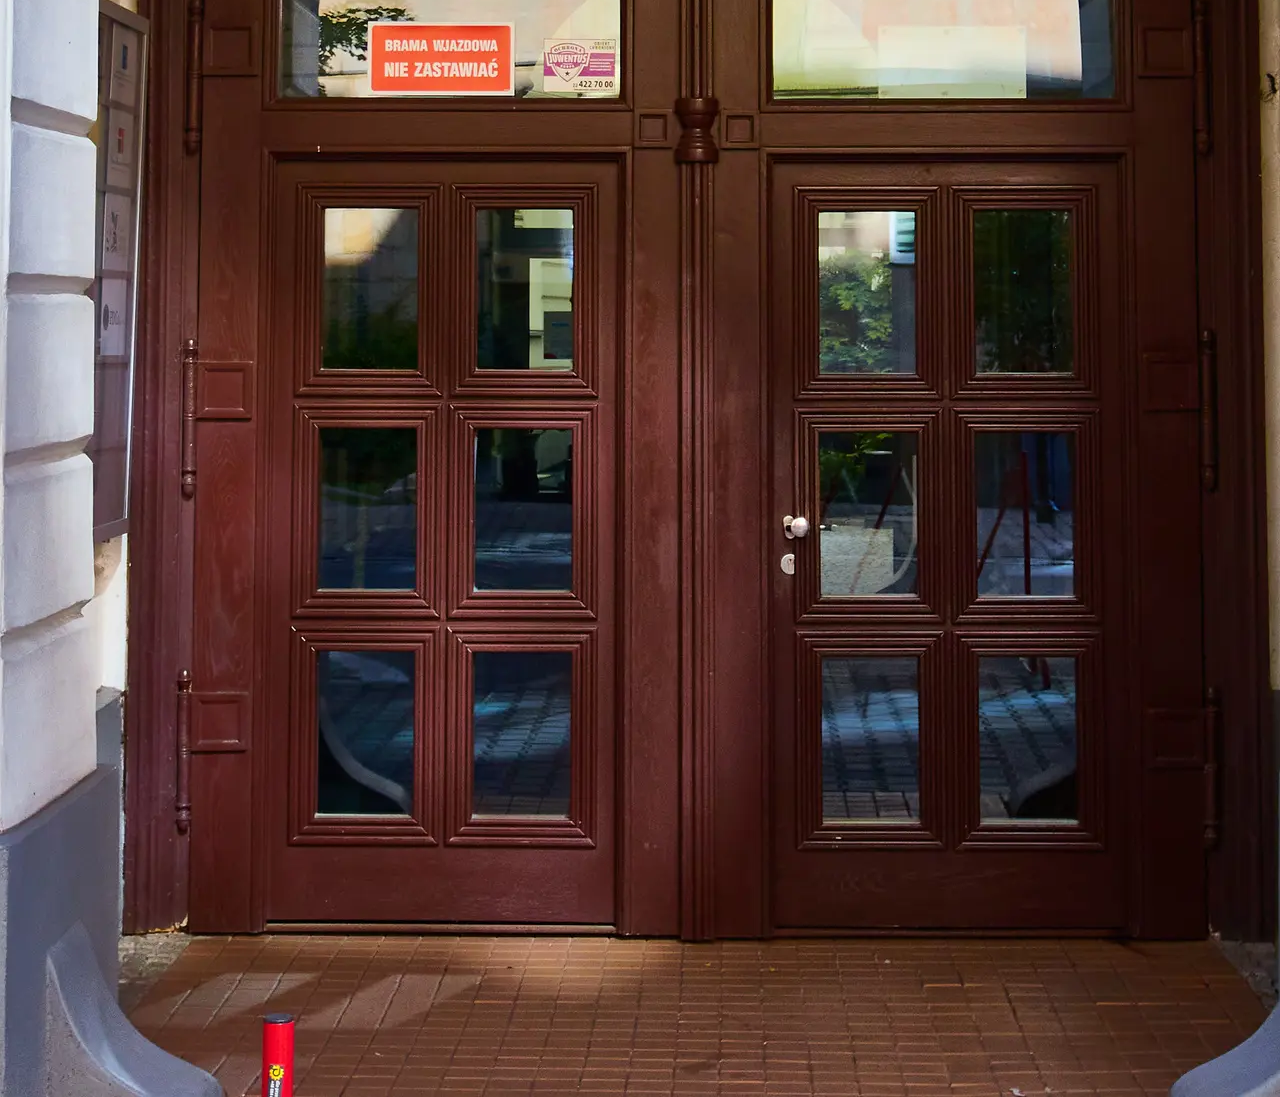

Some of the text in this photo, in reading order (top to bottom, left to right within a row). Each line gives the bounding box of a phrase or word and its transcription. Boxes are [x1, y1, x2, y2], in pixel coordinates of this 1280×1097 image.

[384, 39, 499, 52] BRAMA WJAZDOWA
[548, 53, 588, 64] JUWENTUS
[384, 58, 499, 78] NIE ZASTAWIAĆ
[579, 80, 592, 88] 422
[594, 80, 603, 88] 70
[604, 80, 614, 88] 00
